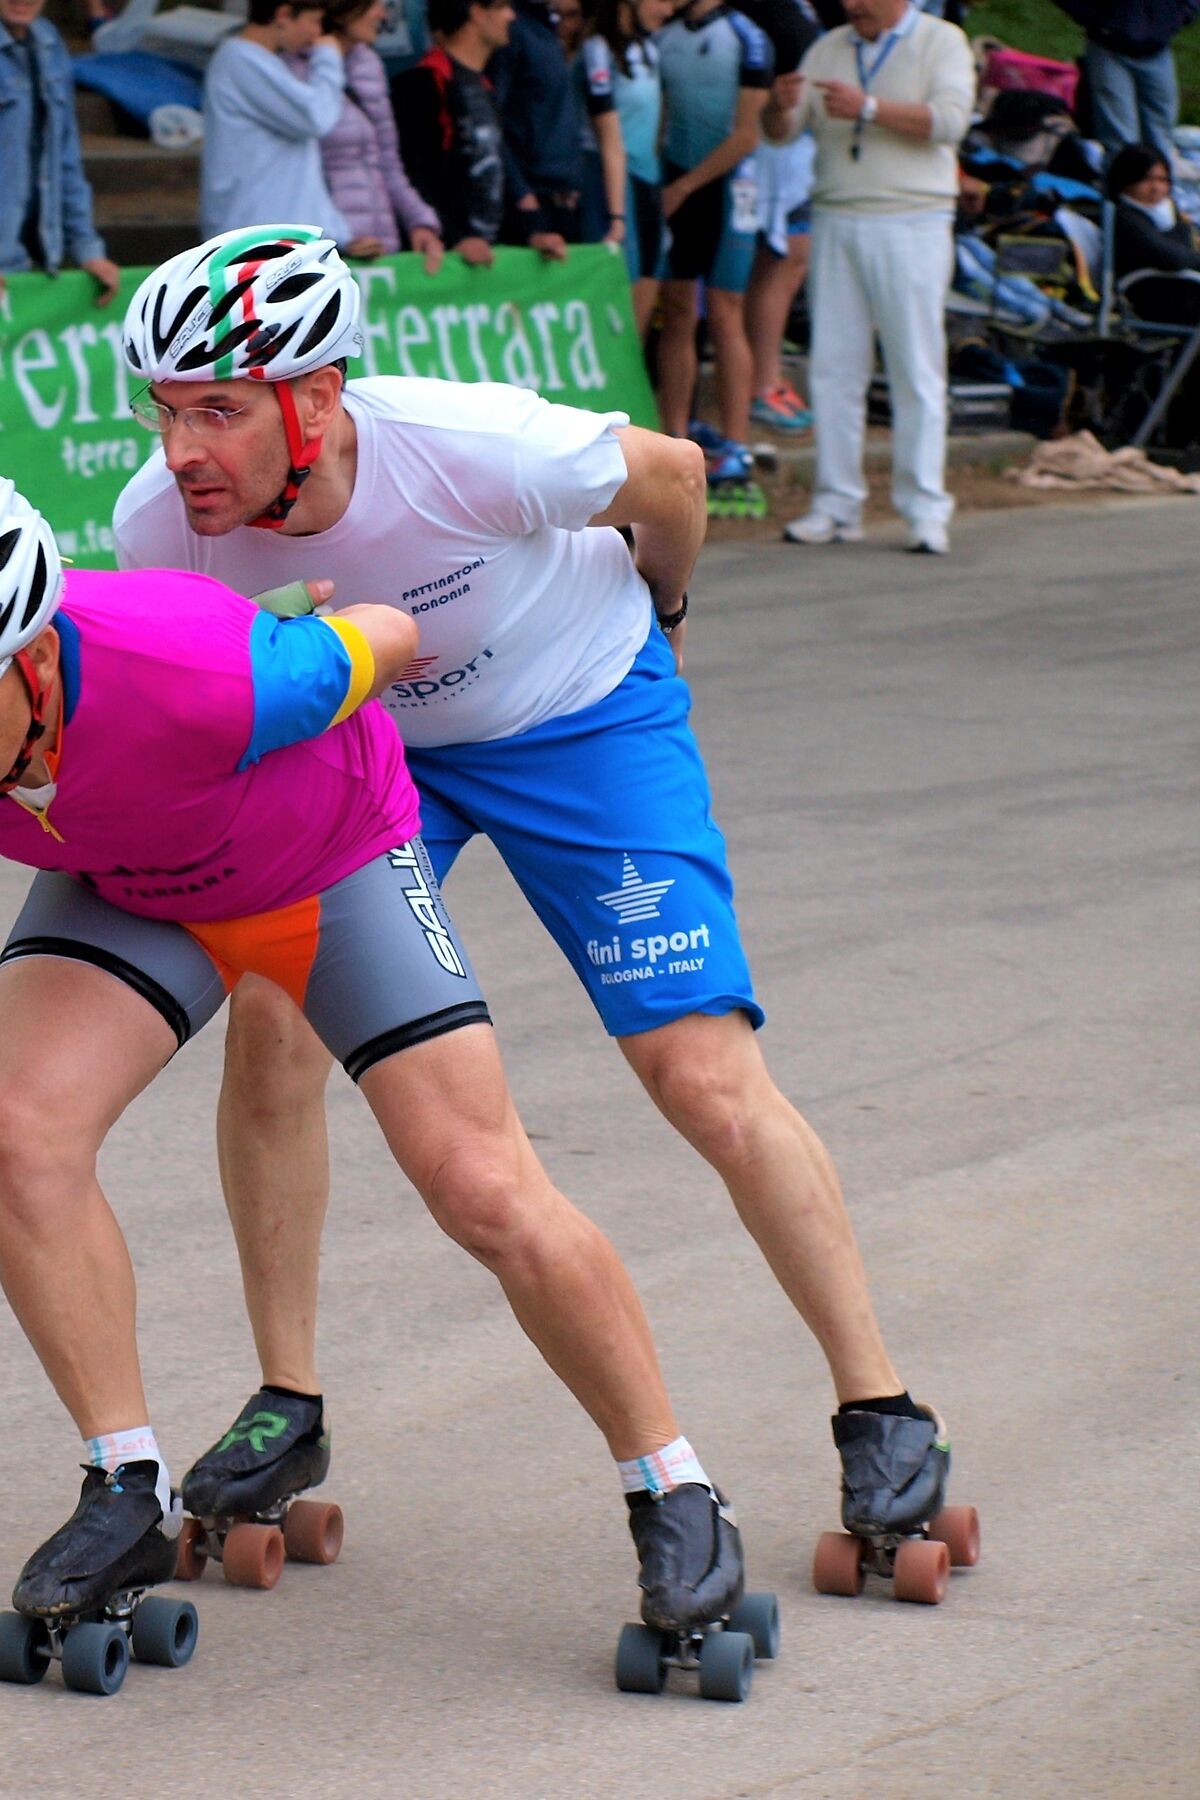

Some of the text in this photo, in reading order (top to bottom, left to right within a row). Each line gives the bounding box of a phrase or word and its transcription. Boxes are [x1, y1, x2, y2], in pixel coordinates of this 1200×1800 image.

[61, 436, 138, 478] terra
[402, 556, 486, 601] PATTINATORI
[411, 583, 471, 615] BONONIA
[631, 924, 710, 963] sport
[601, 966, 655, 985] BOLOGNA
[668, 958, 705, 975] ITALY
